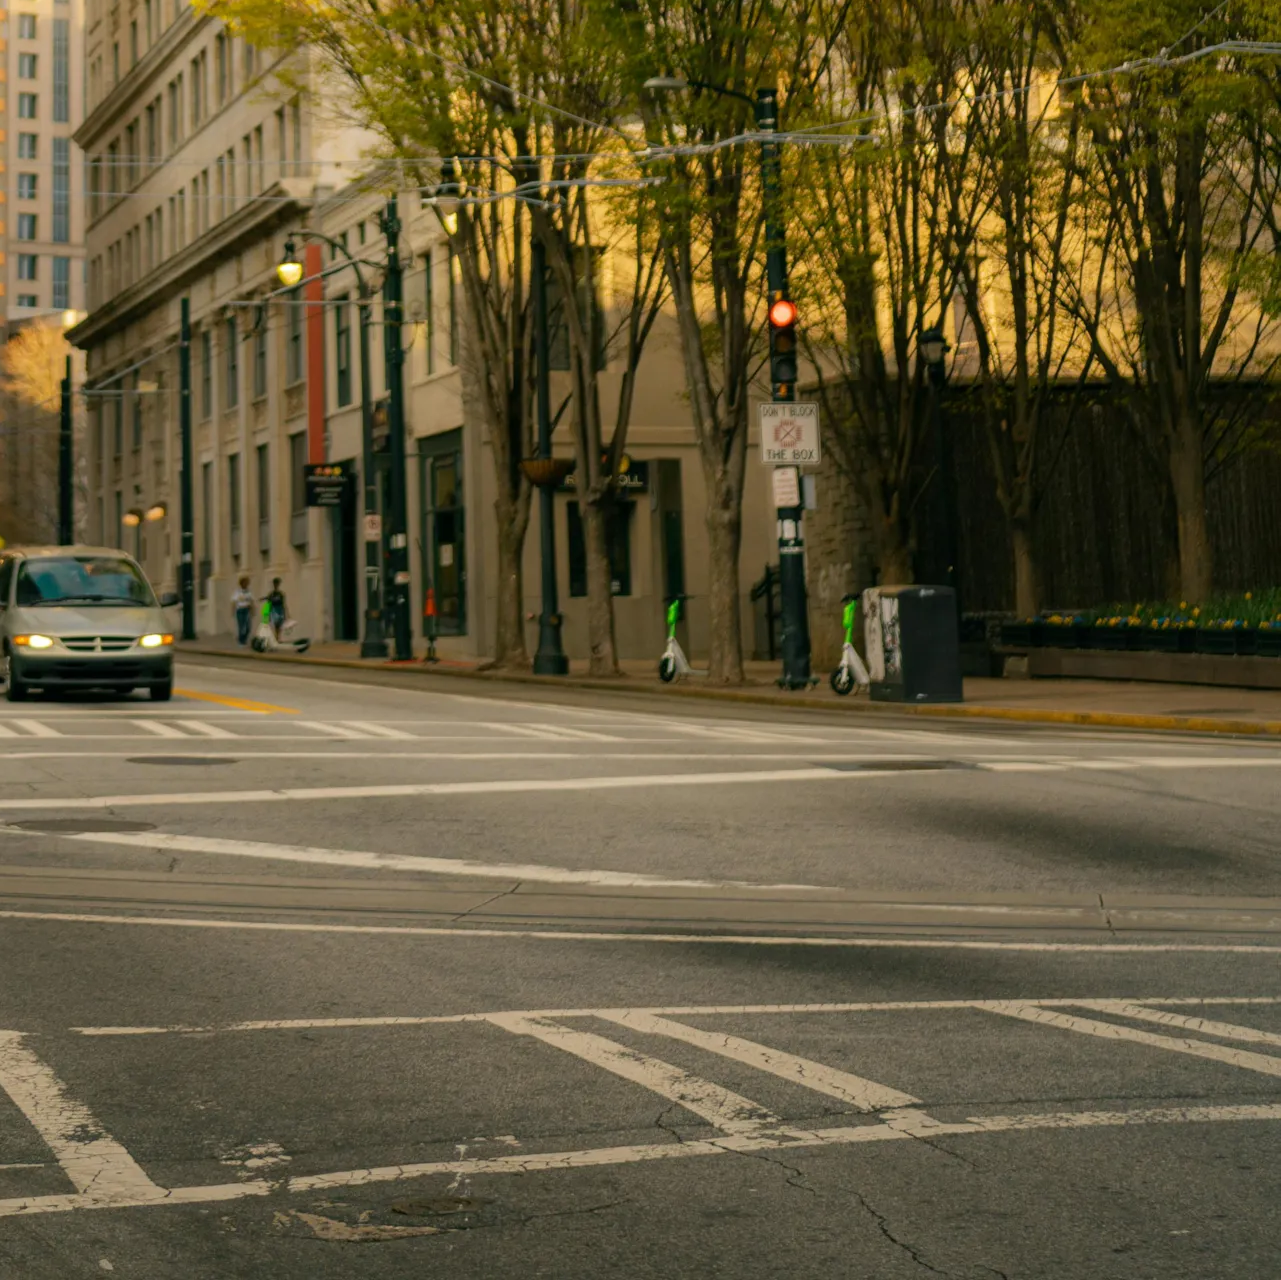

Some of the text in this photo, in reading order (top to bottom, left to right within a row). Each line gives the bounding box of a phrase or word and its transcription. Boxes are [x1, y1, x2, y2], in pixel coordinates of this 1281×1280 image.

[790, 406, 816, 417] BLOCK
[767, 449, 814, 460] THE BOX
